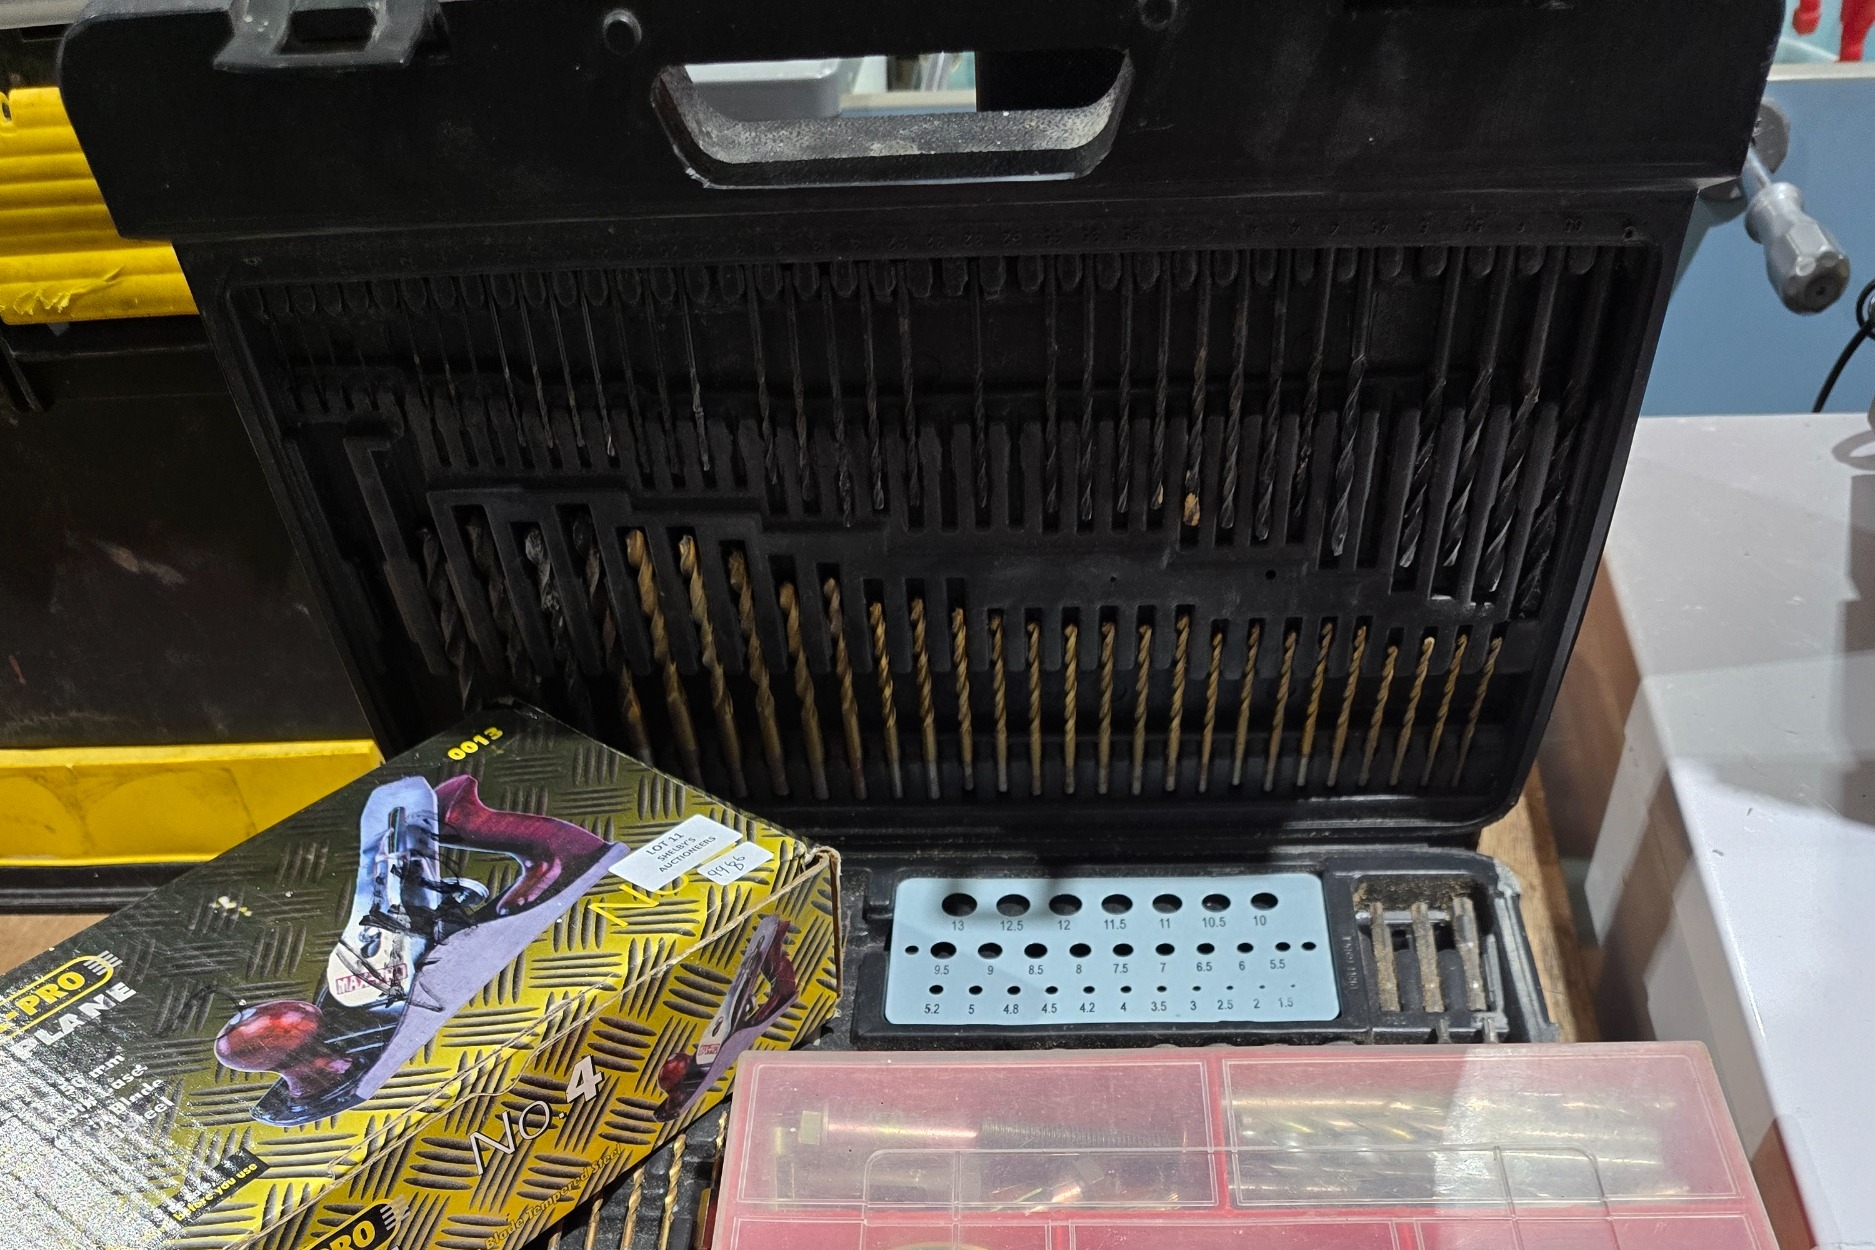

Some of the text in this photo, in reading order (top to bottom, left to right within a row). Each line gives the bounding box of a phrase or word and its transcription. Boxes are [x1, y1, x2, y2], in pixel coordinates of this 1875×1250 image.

[447, 726, 504, 761] 0013
[646, 832, 685, 856] LOT 11
[657, 837, 696, 862] SHELBY'S
[659, 836, 717, 873] AUCTIONEERS
[951, 915, 1267, 932] 13 12.5 12 11.5 11 10.5 10
[934, 958, 1286, 976] 9.5 9 8.5 8 7.5 7 6.5 6 5.5
[10, 981, 137, 1060] PLANE
[923, 997, 1294, 1015] 5.2 5 4.8 4.5 4.2 4 3.5 3 2.5 2 1.5
[470, 1054, 603, 1176] No. 4
[215, 1177, 236, 1196] you
[236, 1163, 258, 1179] use
[485, 1216, 525, 1250] Blade
[525, 1167, 590, 1220] Tempered
[591, 1142, 623, 1175] Steel
